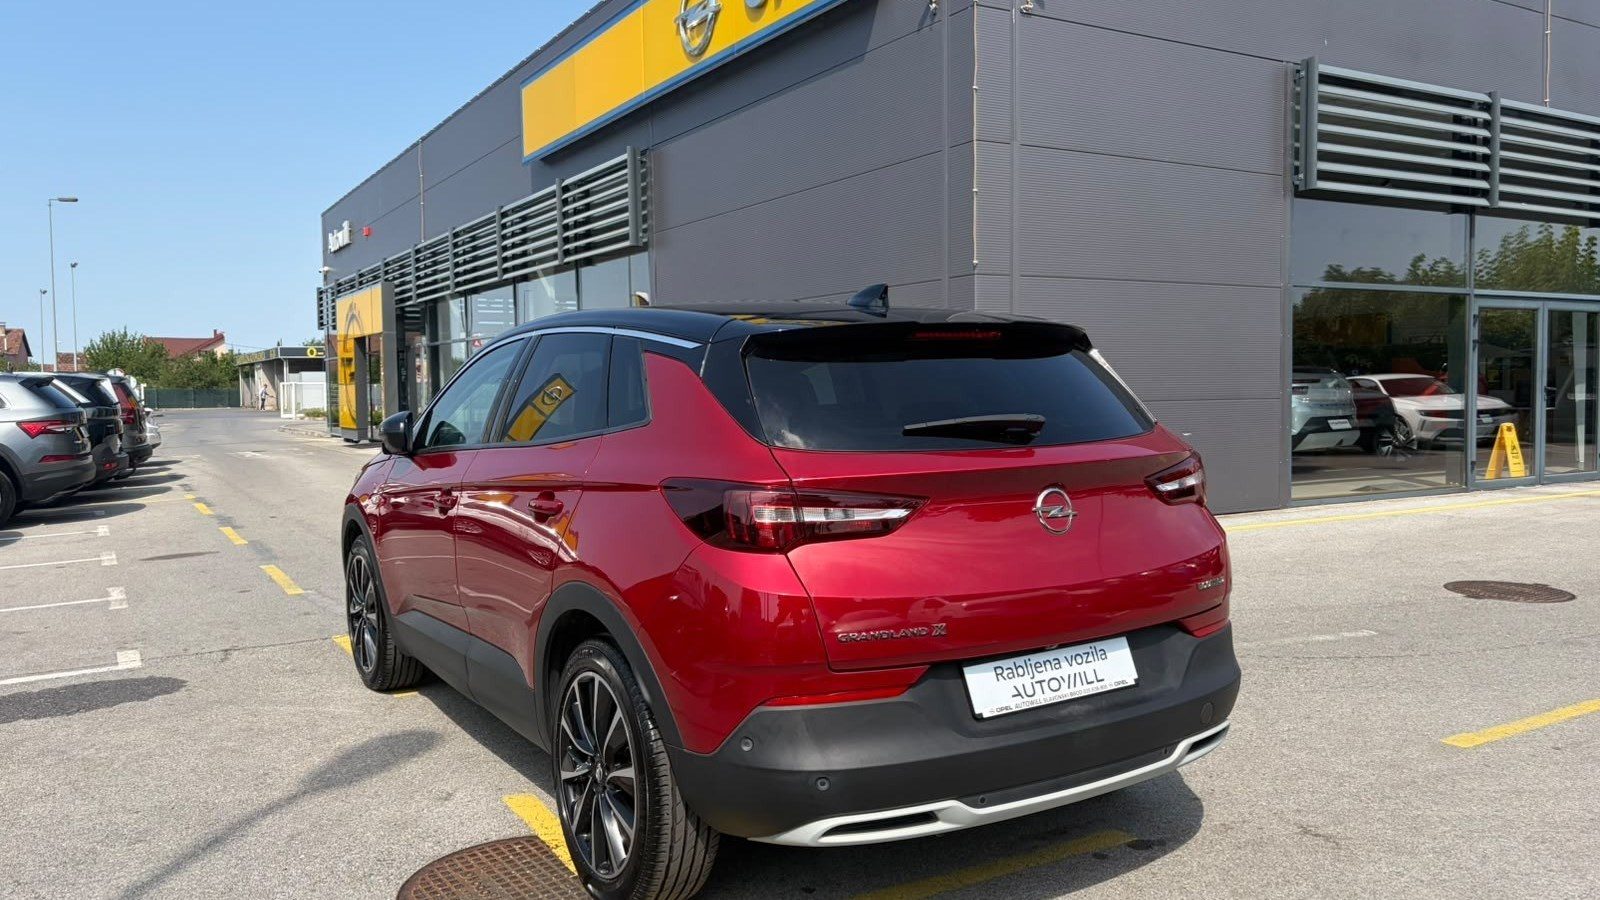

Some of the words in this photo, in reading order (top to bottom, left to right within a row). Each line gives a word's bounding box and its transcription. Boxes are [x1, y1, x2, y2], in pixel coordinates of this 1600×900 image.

[837, 627, 928, 642] GRANDLAND
[931, 622, 947, 636] X
[993, 658, 1062, 682] Rabljena
[1064, 645, 1108, 667] vozila
[1011, 669, 1105, 699] AUTOWILL
[996, 705, 1013, 713] OPEL
